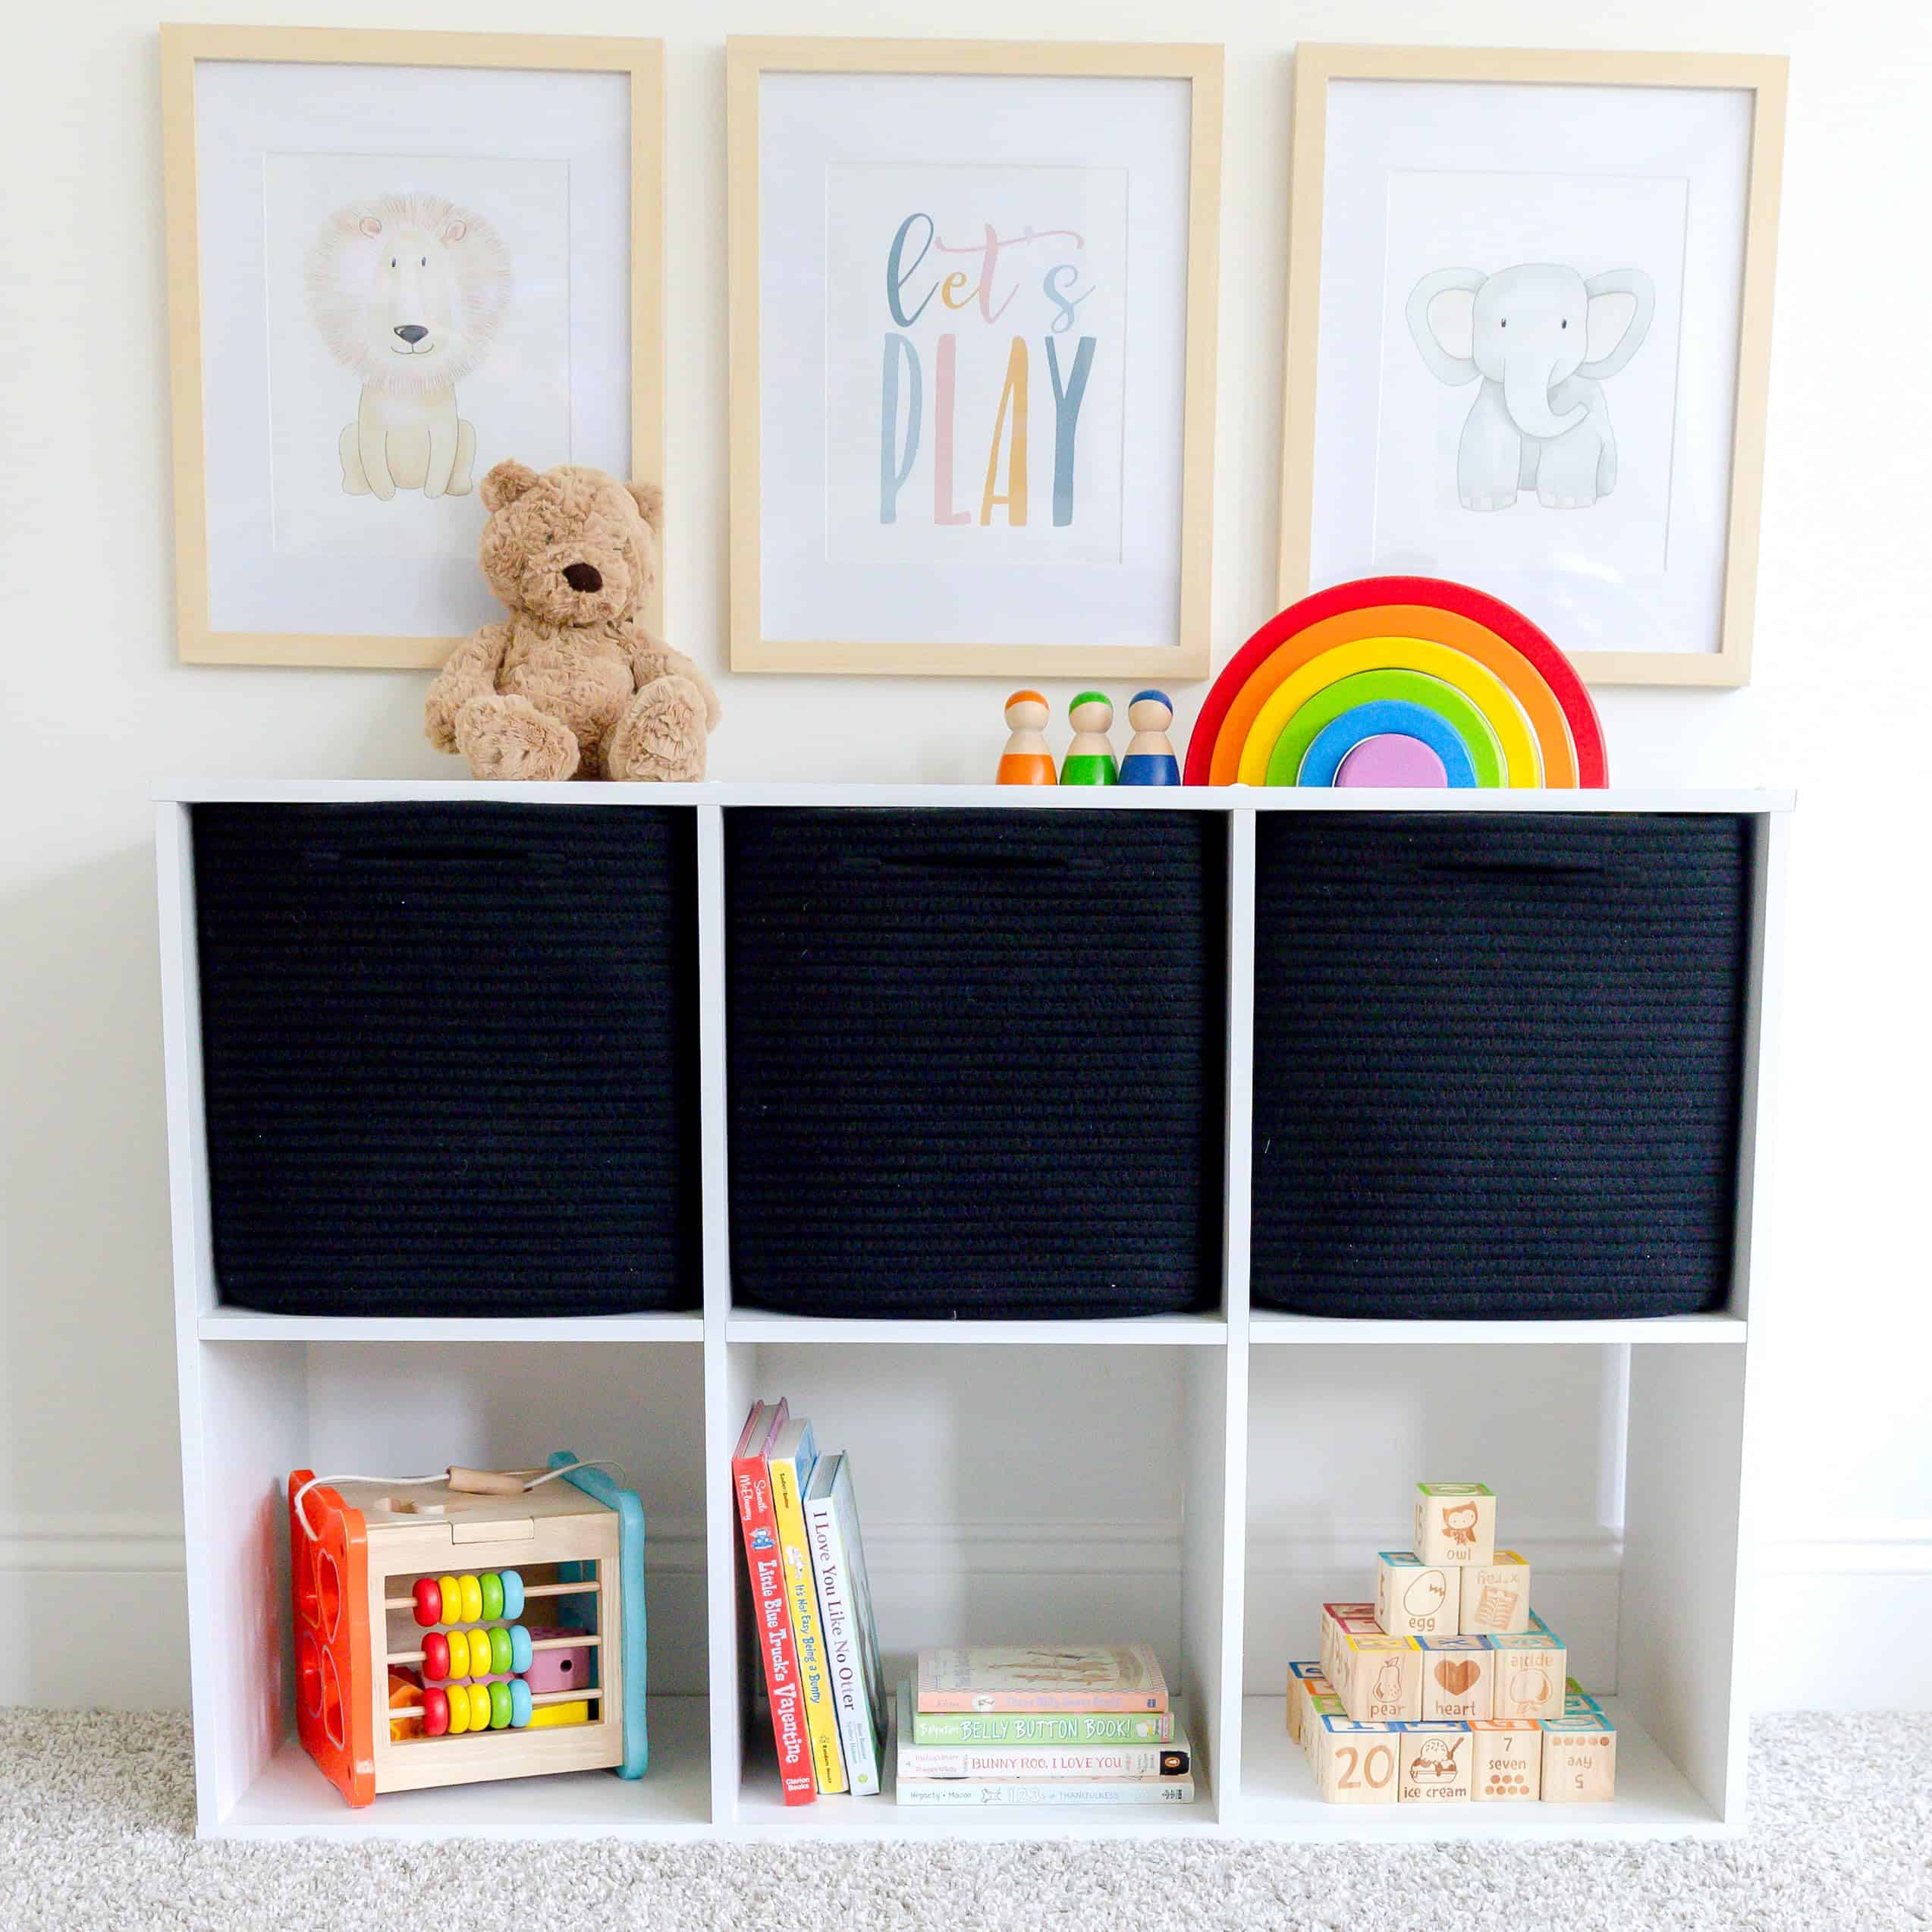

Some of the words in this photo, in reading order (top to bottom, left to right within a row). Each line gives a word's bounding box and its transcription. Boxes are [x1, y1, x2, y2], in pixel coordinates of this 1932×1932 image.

[880, 333, 1097, 527] PLAY
[815, 1523, 831, 1561] Love
[1447, 1547, 1472, 1561] owl
[757, 1560, 778, 1596] Little
[822, 1565, 837, 1596] You
[1477, 1570, 1518, 1585] x-ray
[765, 1597, 782, 1628] Blue
[797, 1598, 807, 1613] Not
[799, 1614, 811, 1635] Easy
[828, 1600, 845, 1635] Like
[1409, 1617, 1436, 1632] egg
[768, 1628, 789, 1682] Truck's
[802, 1635, 816, 1663] Being
[834, 1640, 850, 1663] No
[1511, 1652, 1554, 1669] apple
[809, 1673, 821, 1704] Bunny
[839, 1667, 855, 1711] Otter
[1370, 1704, 1405, 1718] pear
[1435, 1700, 1476, 1717] heart
[774, 1682, 801, 1764] Valentine
[960, 1720, 1009, 1740] BELLY
[1013, 1719, 1078, 1739] BUTTON
[1084, 1718, 1132, 1739] BOOK!
[1503, 1737, 1513, 1752] 7
[972, 1758, 1018, 1769] BUNNY
[1053, 1758, 1057, 1769] I
[1061, 1758, 1094, 1769] LOVE
[1095, 1757, 1123, 1768] YOU
[1335, 1745, 1394, 1789] 20
[1488, 1759, 1527, 1770] seven
[1567, 1756, 1592, 1769] five
[1574, 1773, 1584, 1789] 5
[1403, 1786, 1421, 1798] ice
[1426, 1786, 1467, 1798] cream
